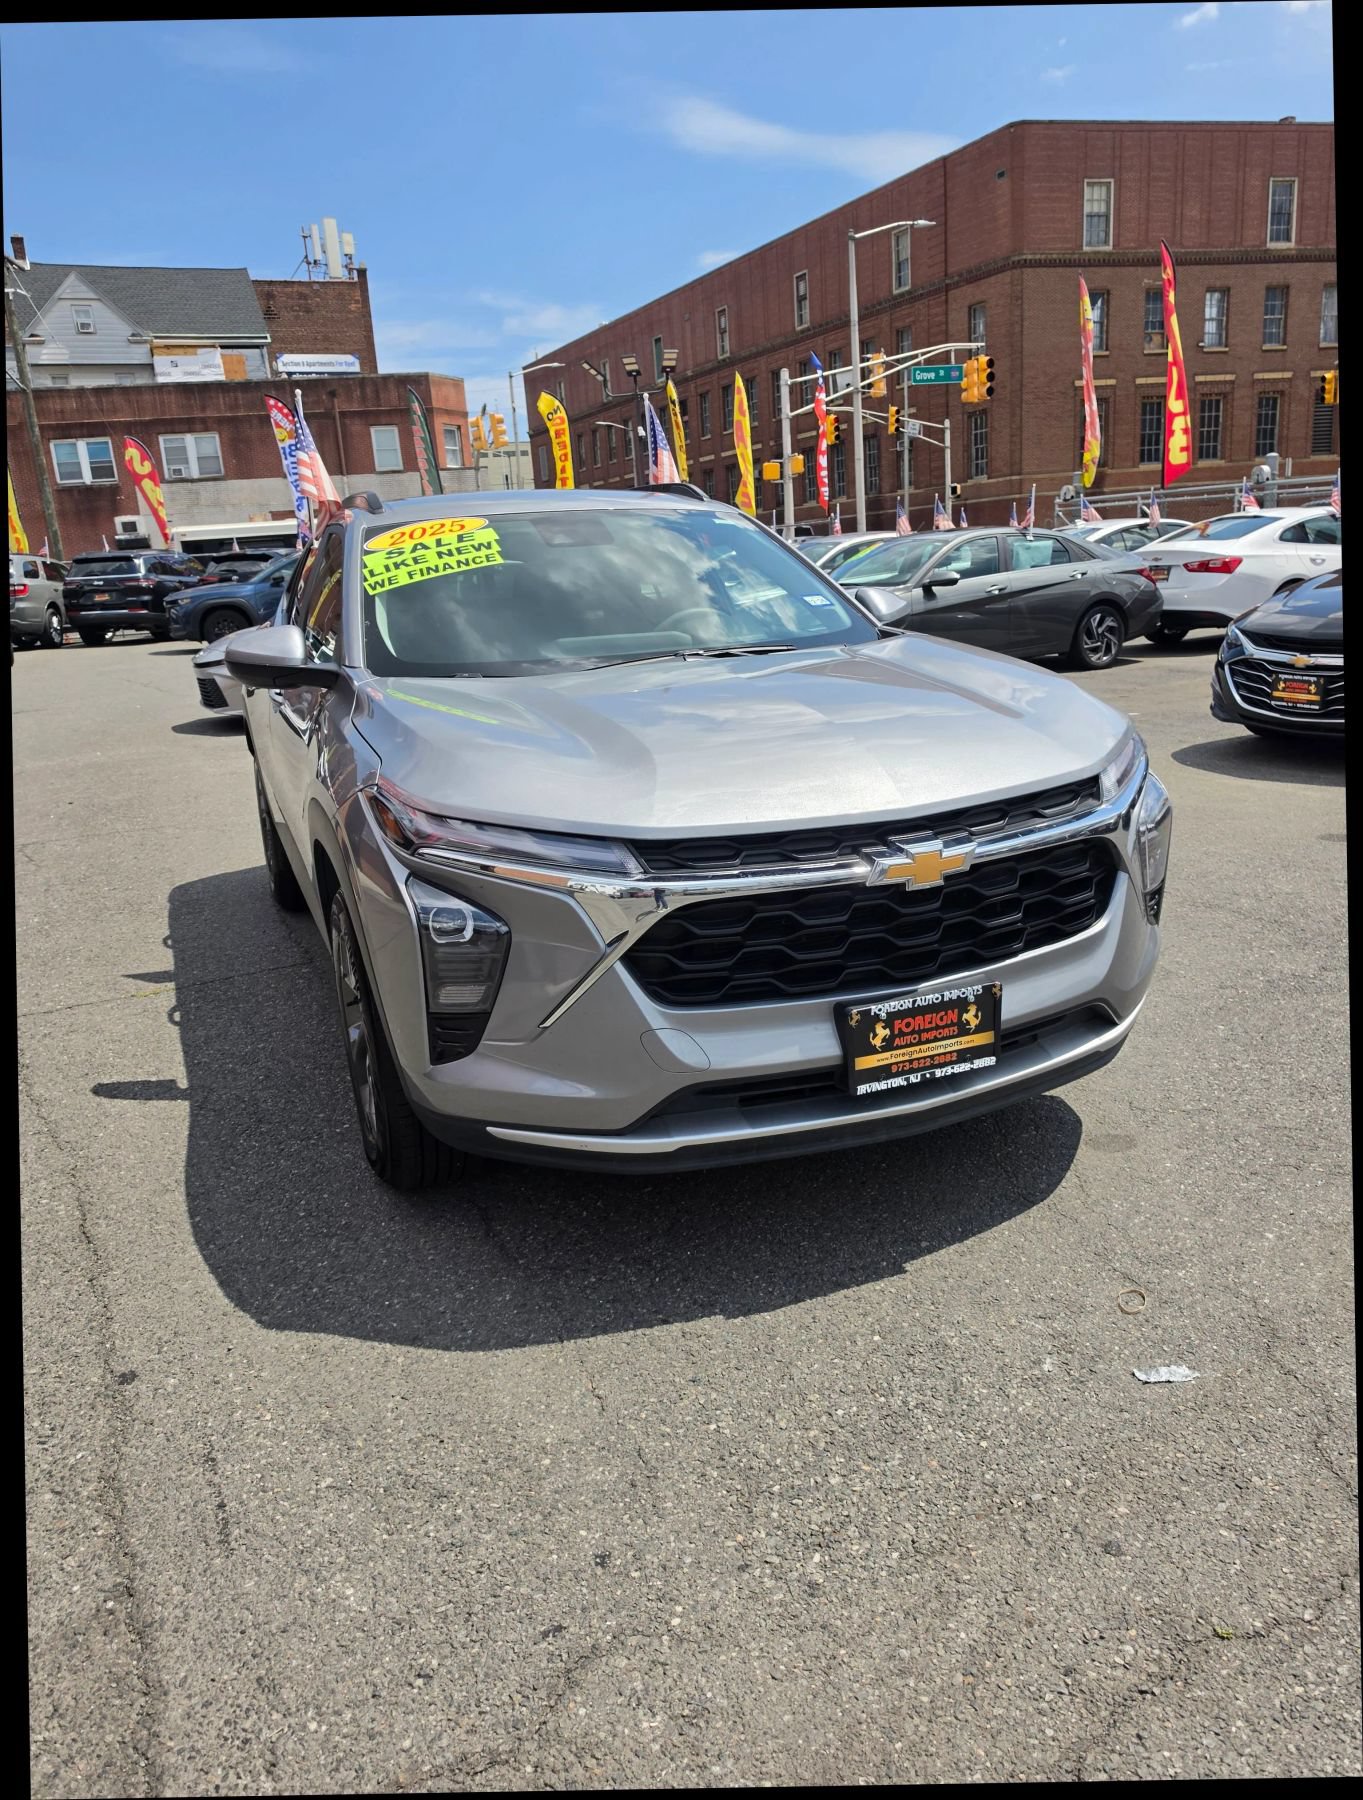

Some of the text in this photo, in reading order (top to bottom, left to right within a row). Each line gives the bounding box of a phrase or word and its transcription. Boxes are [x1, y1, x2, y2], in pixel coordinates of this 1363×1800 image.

[915, 370, 935, 380] Grove
[384, 531, 476, 560] SALE
[388, 519, 466, 547] 2025
[367, 552, 497, 592] WE FINANCE
[368, 541, 493, 578] LIKE NEW
[871, 985, 983, 1016] FOREIGN AUTO IMPORTS
[893, 1008, 959, 1035] FOREIGN
[876, 1038, 975, 1063] www.ForeignAutoImports.com
[893, 1026, 959, 1047] AUTO IMPORTS
[856, 1056, 997, 1096] IRVINGTON, NJ 973-622-2882
[891, 1052, 958, 1073] 973-622-2882
